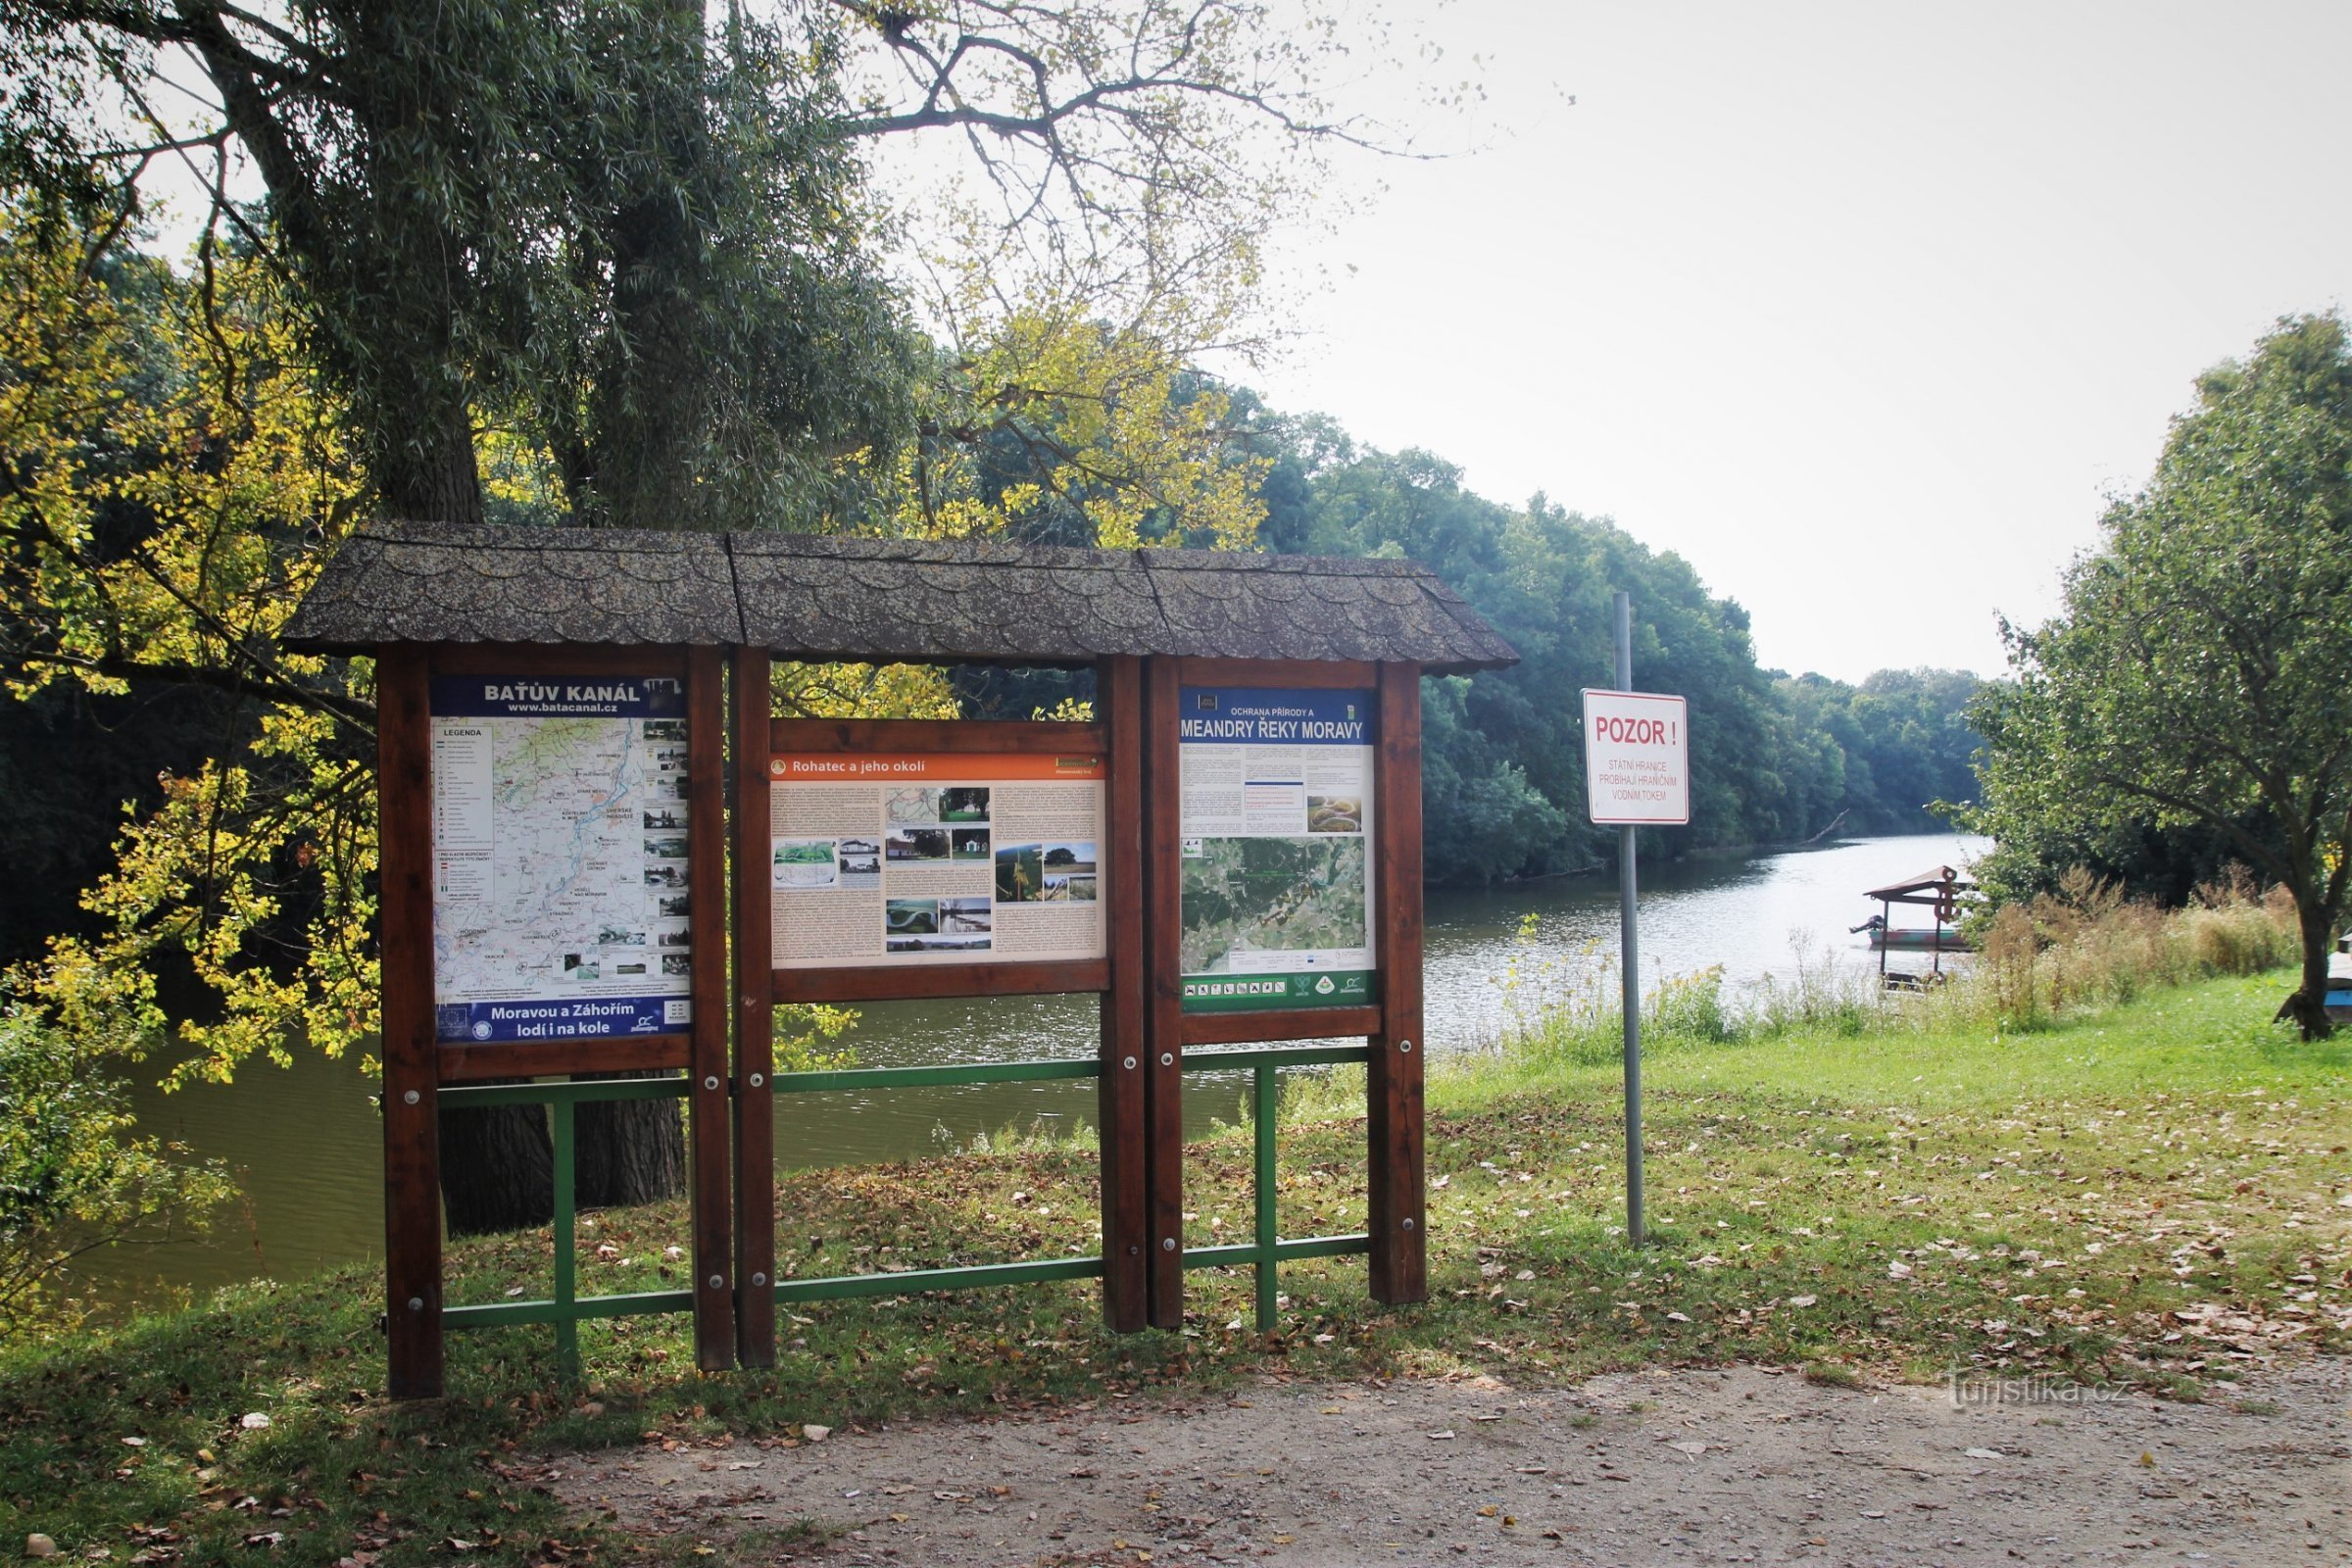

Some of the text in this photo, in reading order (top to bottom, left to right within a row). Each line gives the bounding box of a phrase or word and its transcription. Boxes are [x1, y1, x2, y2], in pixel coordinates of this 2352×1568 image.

[484, 681, 640, 702] BAŤŮV KANÁL
[508, 703, 617, 712] www.batacanal.cz
[1231, 707, 1270, 716] OCHRANA
[1271, 706, 1306, 717] PŘÍRODY
[1181, 716, 1363, 739] MEANDRY ŘEKY MORAVY
[1595, 716, 1665, 745] POZOR
[792, 760, 925, 775] Rohatec a jeho okolí
[1608, 759, 1667, 772] STÁTNÍ HRANICE
[1642, 790, 1667, 801] TOKEM
[491, 1003, 635, 1020] Moravou a Záhořím
[517, 1021, 610, 1037] lodí i na kole
